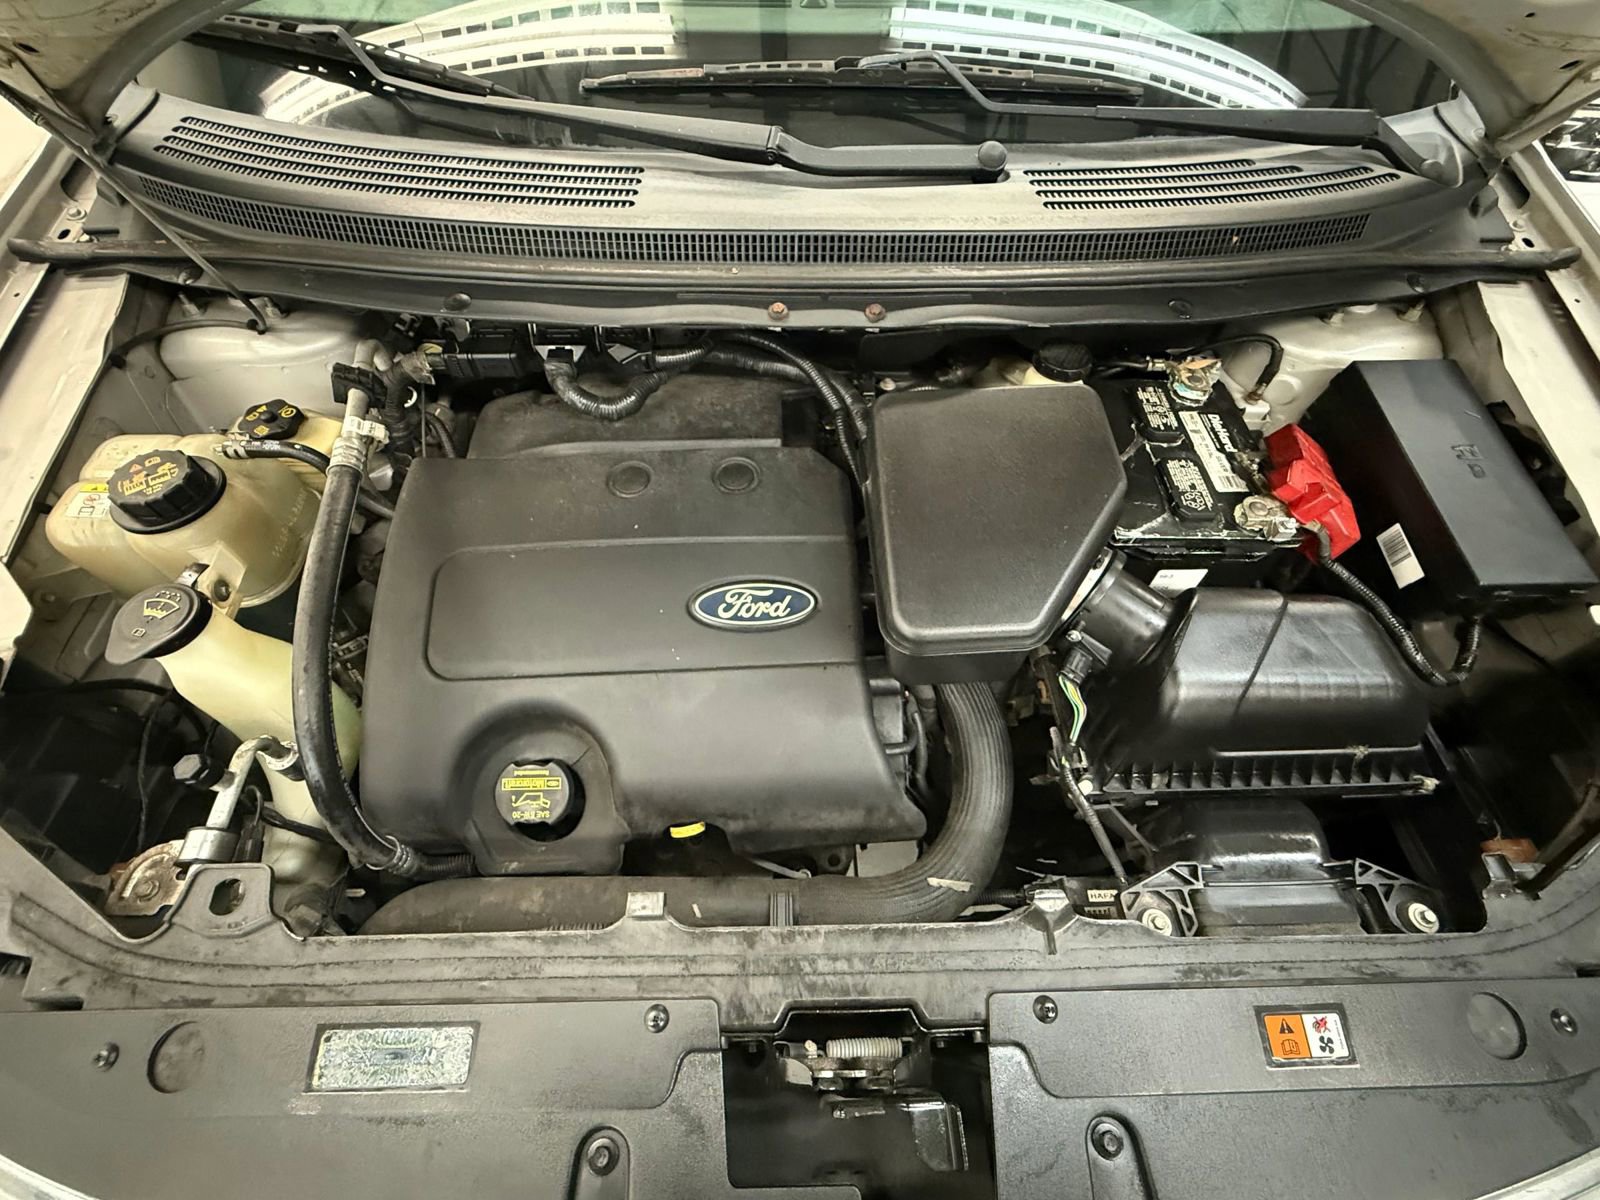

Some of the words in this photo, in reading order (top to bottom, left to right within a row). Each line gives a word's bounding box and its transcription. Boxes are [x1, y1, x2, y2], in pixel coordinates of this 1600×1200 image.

[1207, 414, 1238, 452] DieHard
[718, 589, 792, 618] Ford
[536, 810, 550, 818] SAE
